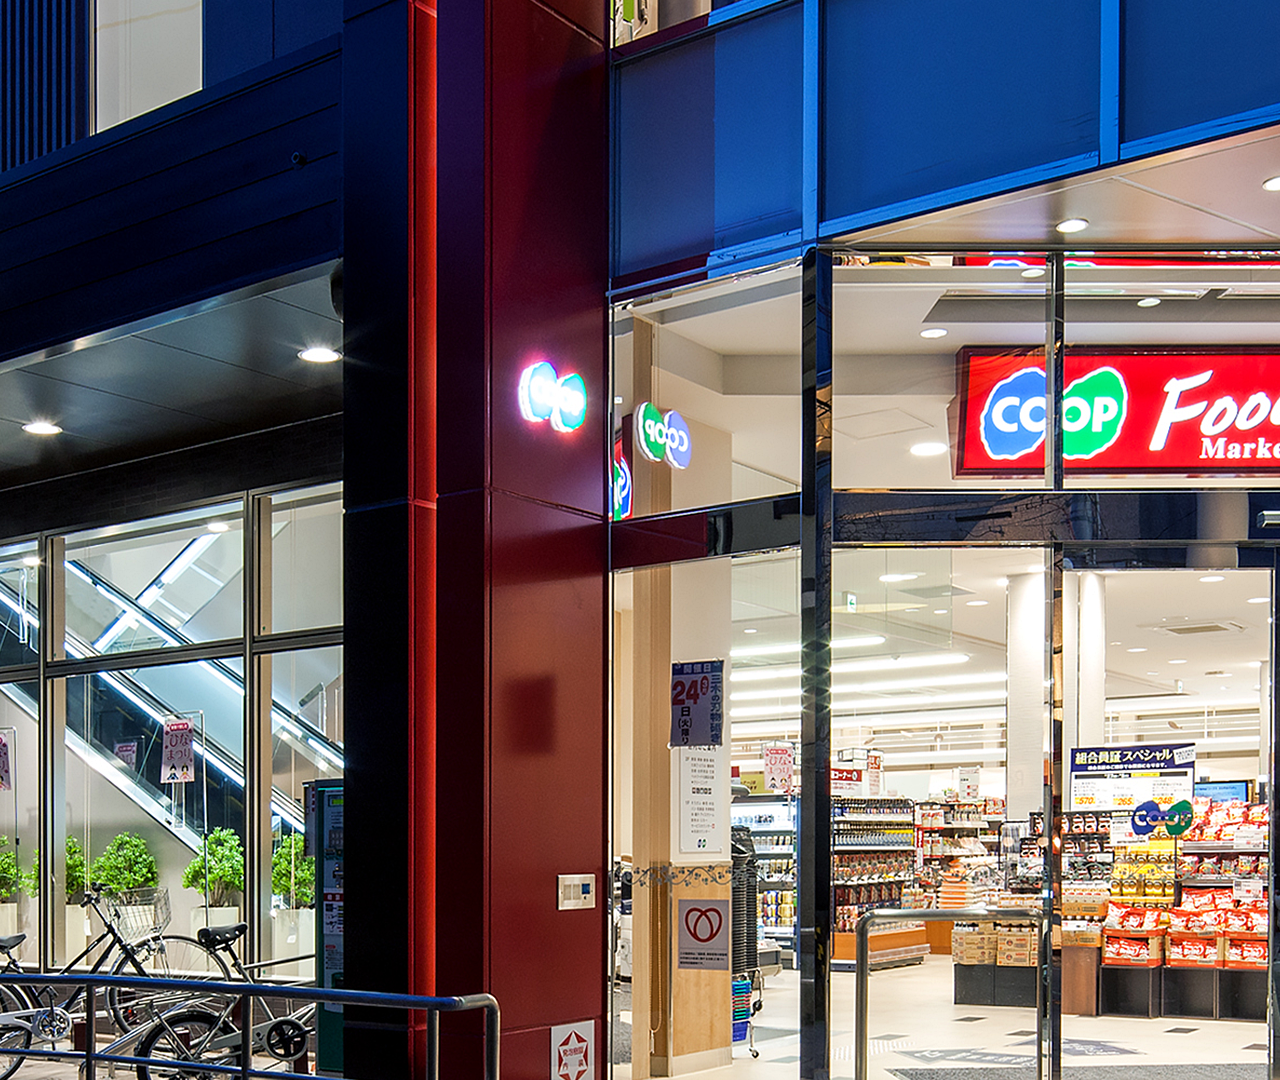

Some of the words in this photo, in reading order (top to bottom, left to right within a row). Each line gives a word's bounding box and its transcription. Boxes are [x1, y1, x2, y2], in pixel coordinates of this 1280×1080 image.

[671, 679, 700, 706] 24
[166, 748, 191, 761] まつり
